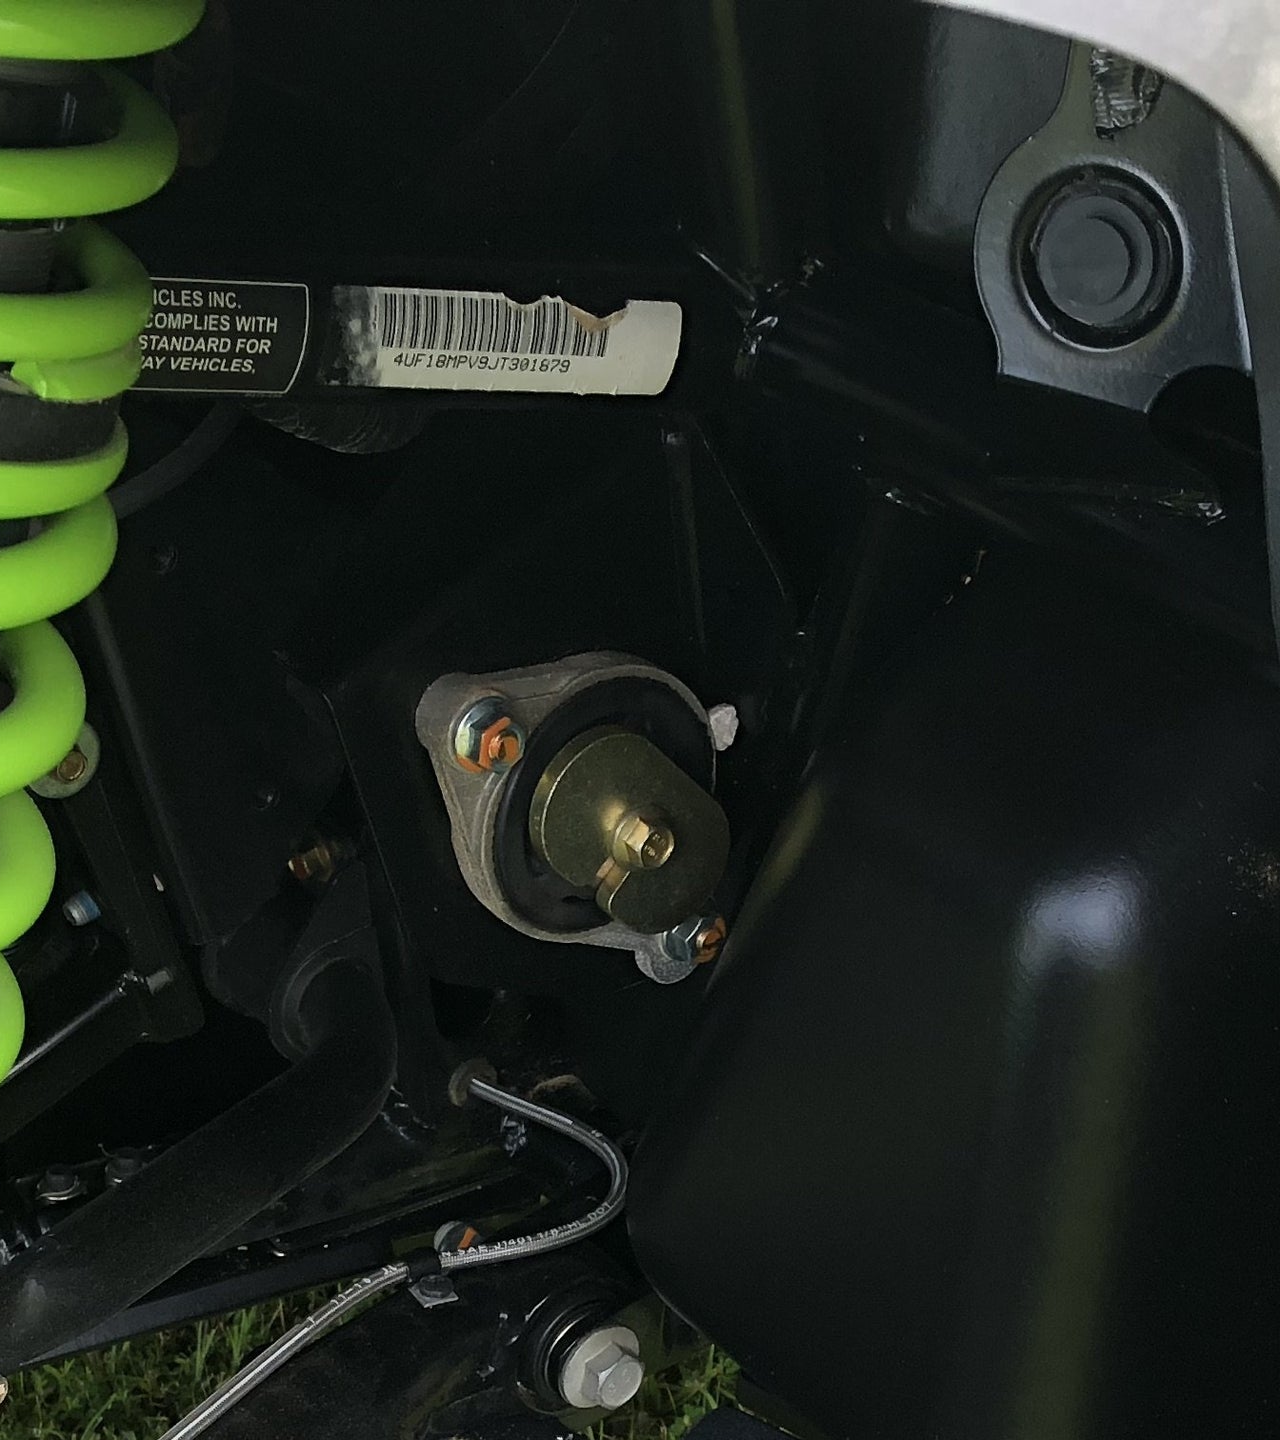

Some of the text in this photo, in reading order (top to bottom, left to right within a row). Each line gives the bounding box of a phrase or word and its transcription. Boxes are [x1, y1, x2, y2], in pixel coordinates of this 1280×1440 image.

[208, 291, 242, 309] INC.
[235, 316, 278, 334] WITH
[138, 334, 272, 354] STANDARD FOR
[141, 356, 166, 370] AY
